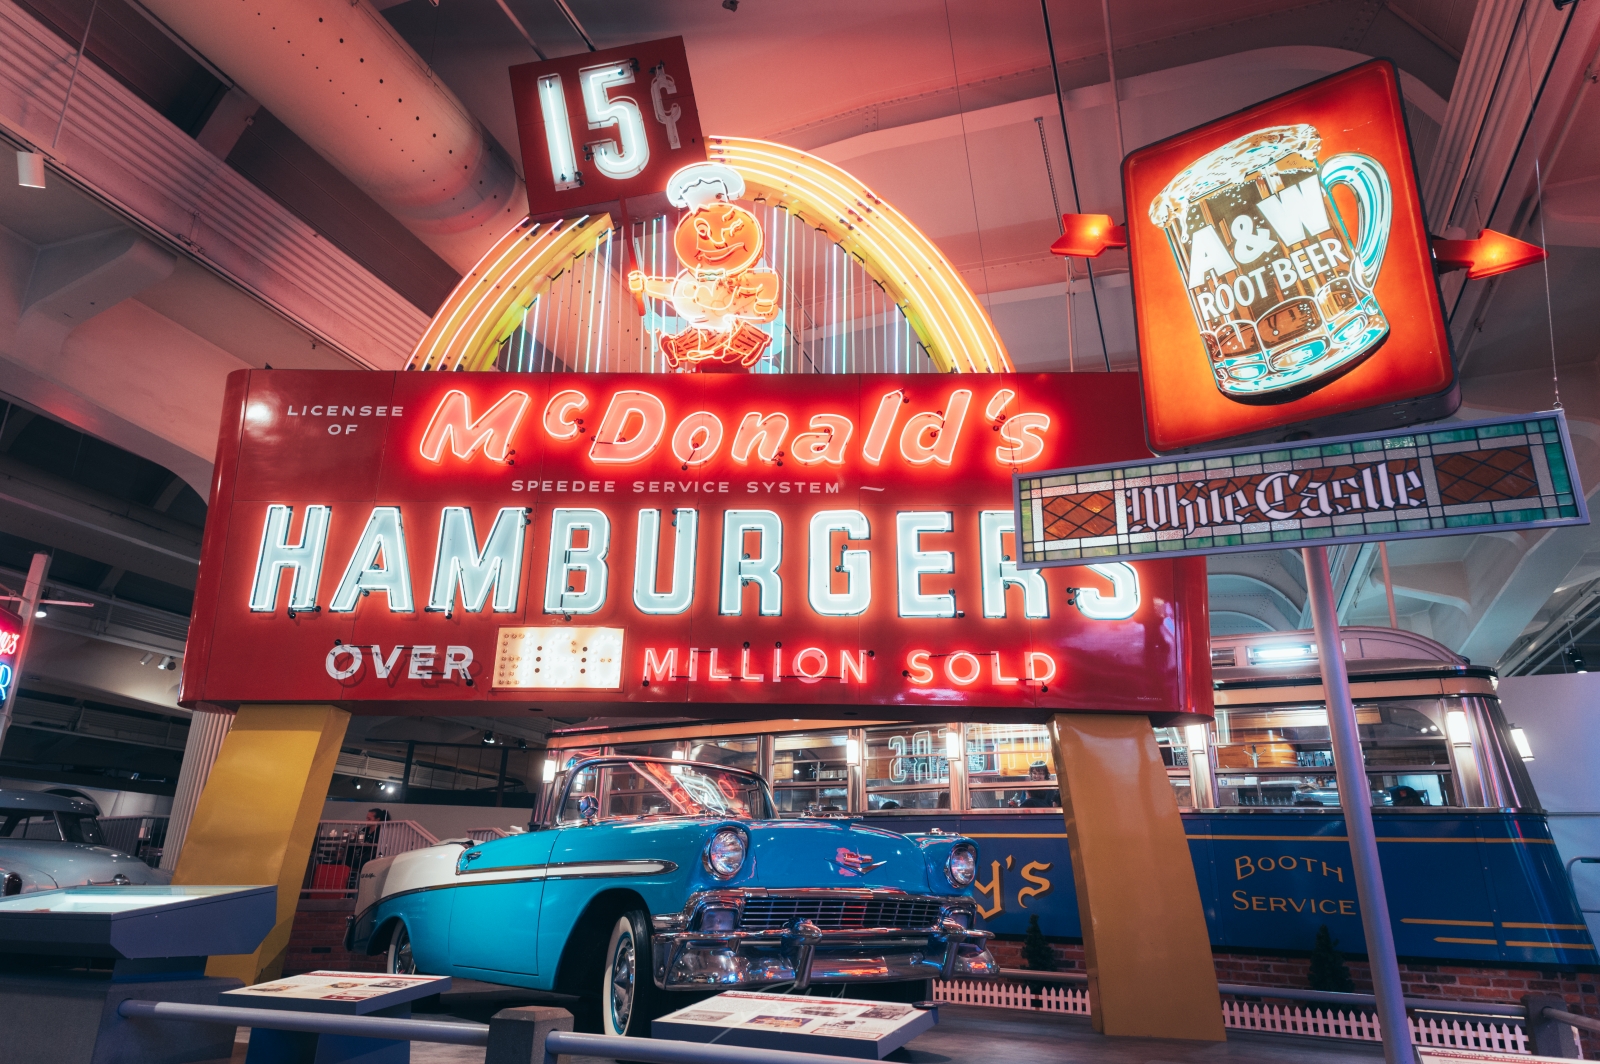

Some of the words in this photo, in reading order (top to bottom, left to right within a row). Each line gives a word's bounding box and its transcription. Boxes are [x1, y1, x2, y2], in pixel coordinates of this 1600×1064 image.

[537, 59, 681, 191] 15¢
[1188, 174, 1332, 290] A&W
[1196, 269, 1271, 322] ROOT
[1271, 238, 1350, 290] BEER
[287, 405, 404, 417] LICENSEE
[327, 424, 358, 435] OF
[419, 389, 1051, 466] McDonald's
[511, 480, 616, 493] SPEEDEE
[632, 481, 730, 494] SERVICE
[746, 481, 840, 494] SYSTEM
[1126, 482, 1250, 538] White
[1255, 462, 1426, 520] Castle
[247, 504, 1142, 620] HAMBURGERS
[325, 643, 474, 680] OVER
[643, 647, 868, 684] MILLION
[905, 648, 1057, 686] SOLD
